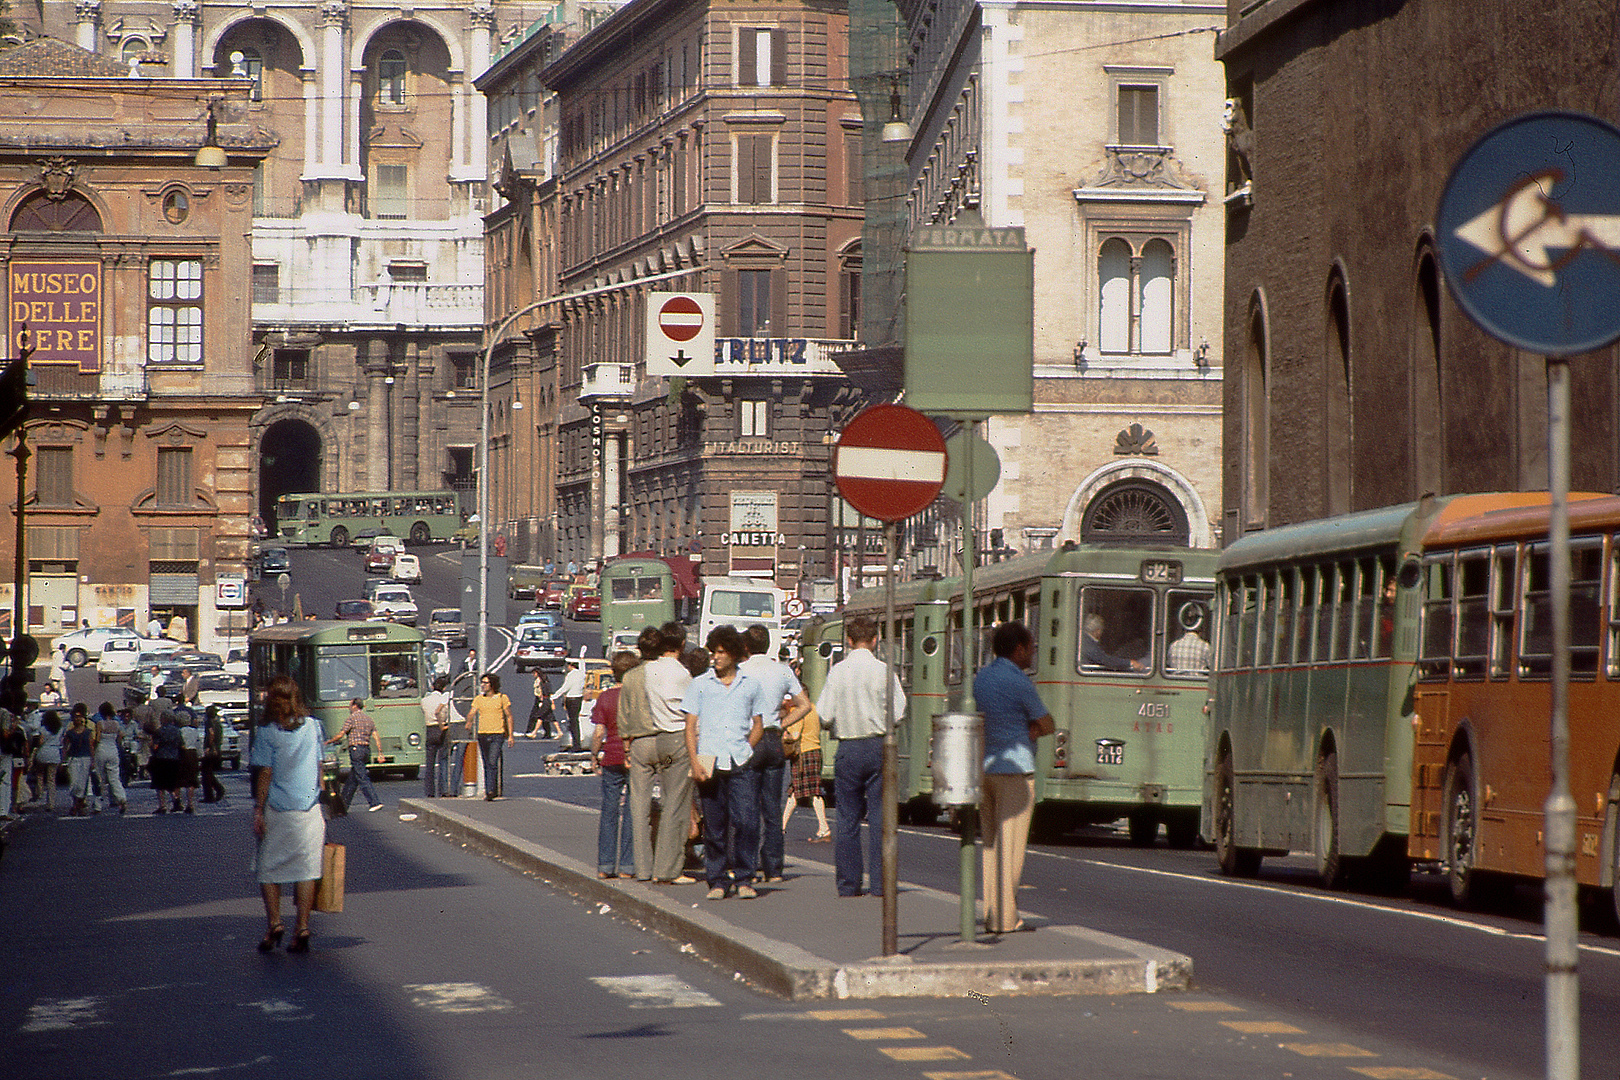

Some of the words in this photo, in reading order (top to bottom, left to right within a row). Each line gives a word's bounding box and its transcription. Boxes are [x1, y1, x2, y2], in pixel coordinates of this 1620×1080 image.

[13, 272, 97, 294] MUSEO
[13, 301, 97, 323] DELLE
[15, 329, 95, 351] CERE
[591, 403, 601, 522] COSMOPOLITA
[720, 532, 786, 546] CANETTA
[836, 534, 883, 546] ANTTA
[1138, 702, 1169, 718] 4051
[1133, 720, 1173, 733] ATAC
